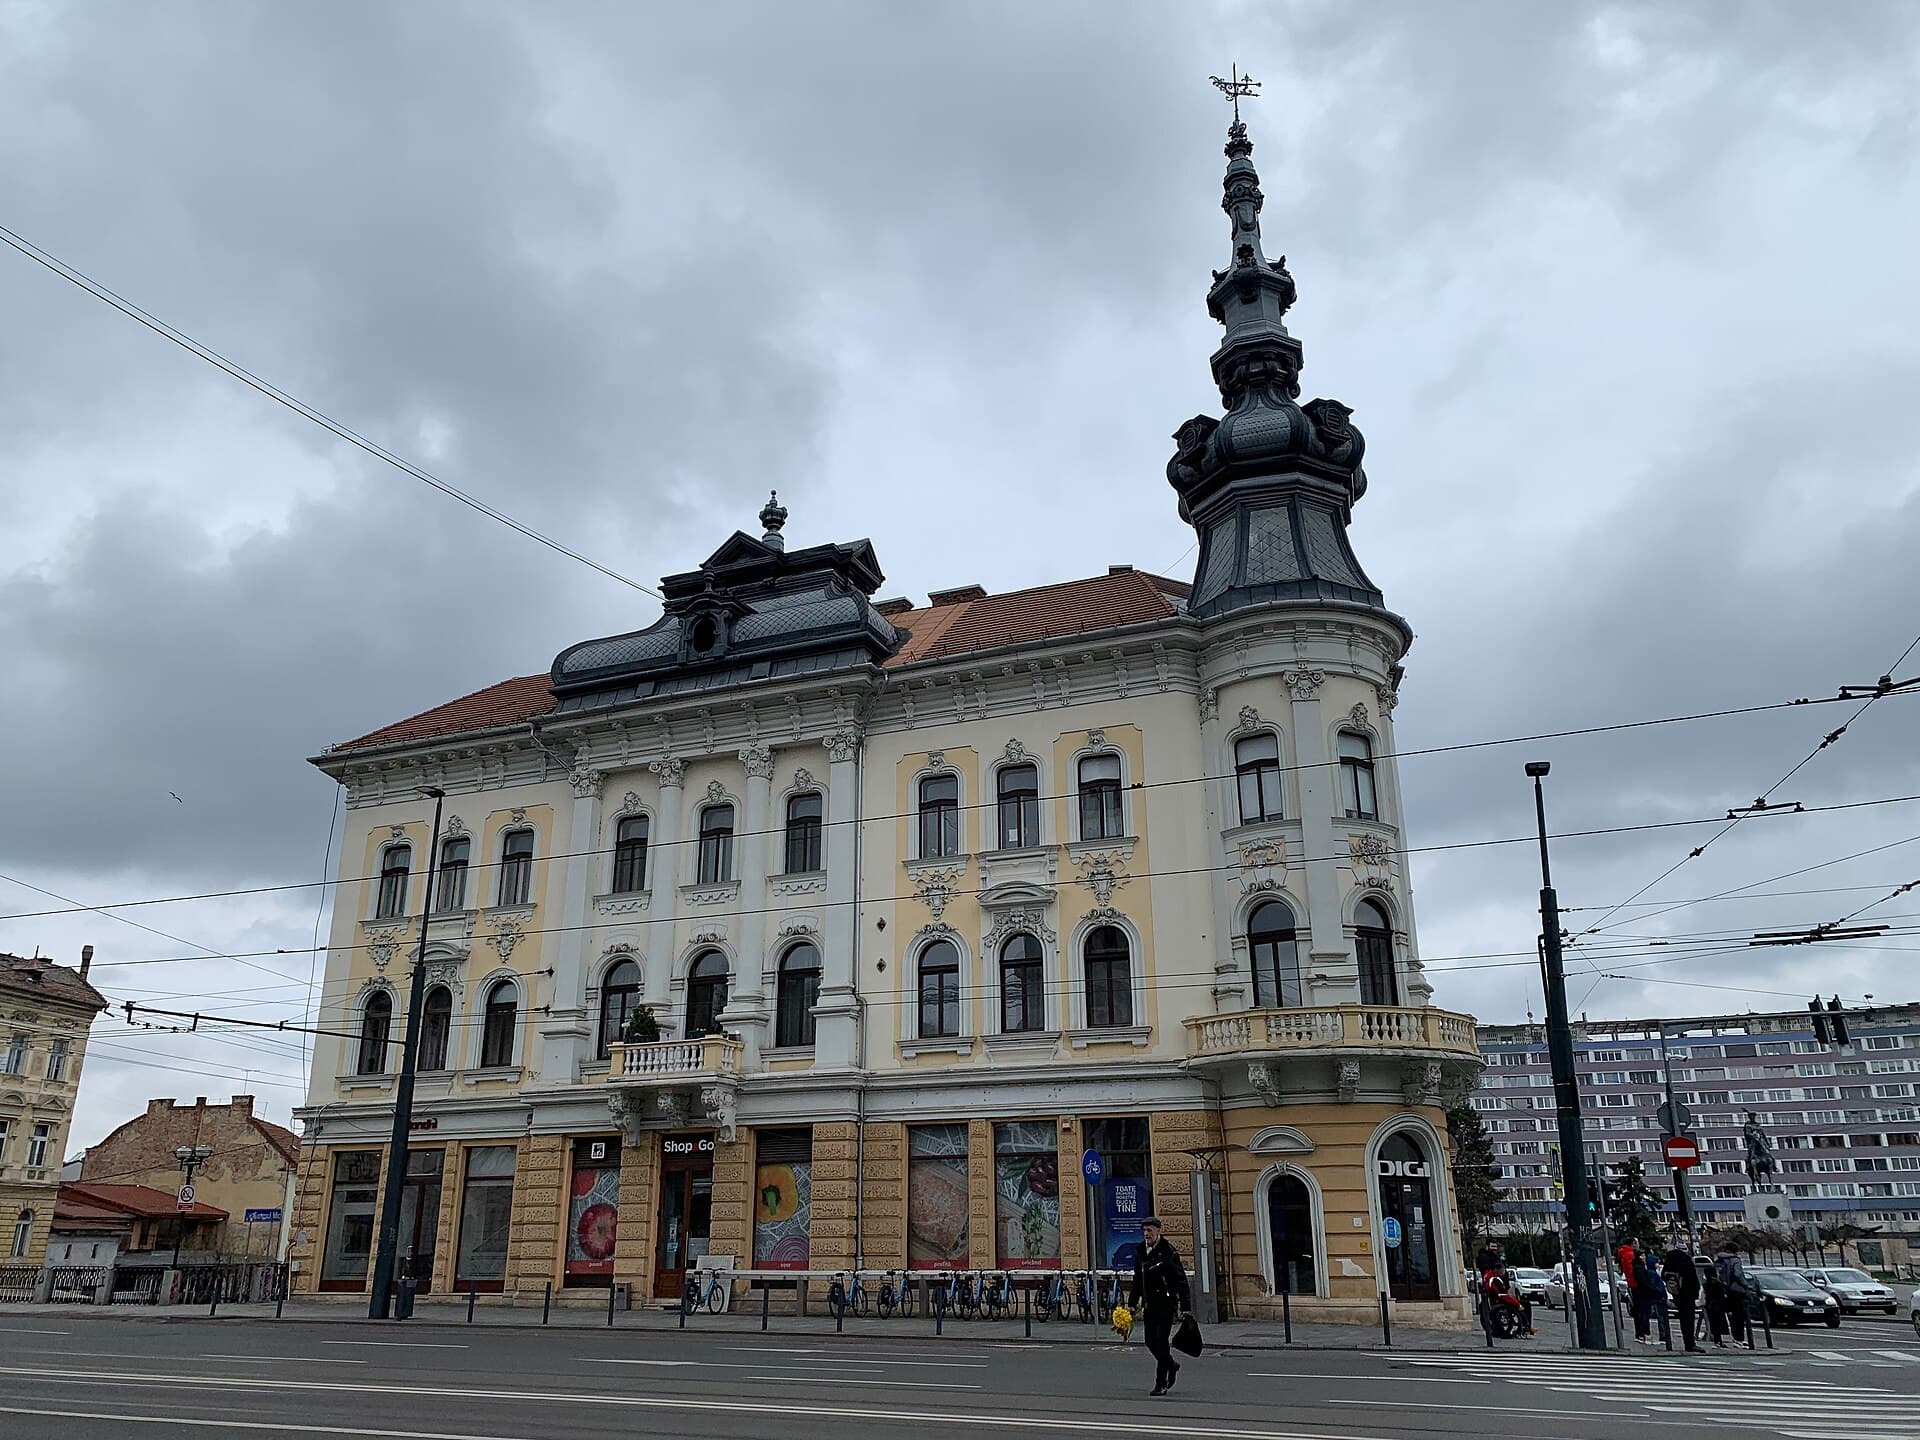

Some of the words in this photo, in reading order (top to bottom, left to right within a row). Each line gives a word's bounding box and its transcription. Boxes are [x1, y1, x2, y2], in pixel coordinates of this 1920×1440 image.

[664, 1139, 715, 1154] Shop&Go
[1378, 1160, 1431, 1177] DIGI
[1116, 1204, 1137, 1213] TINE
